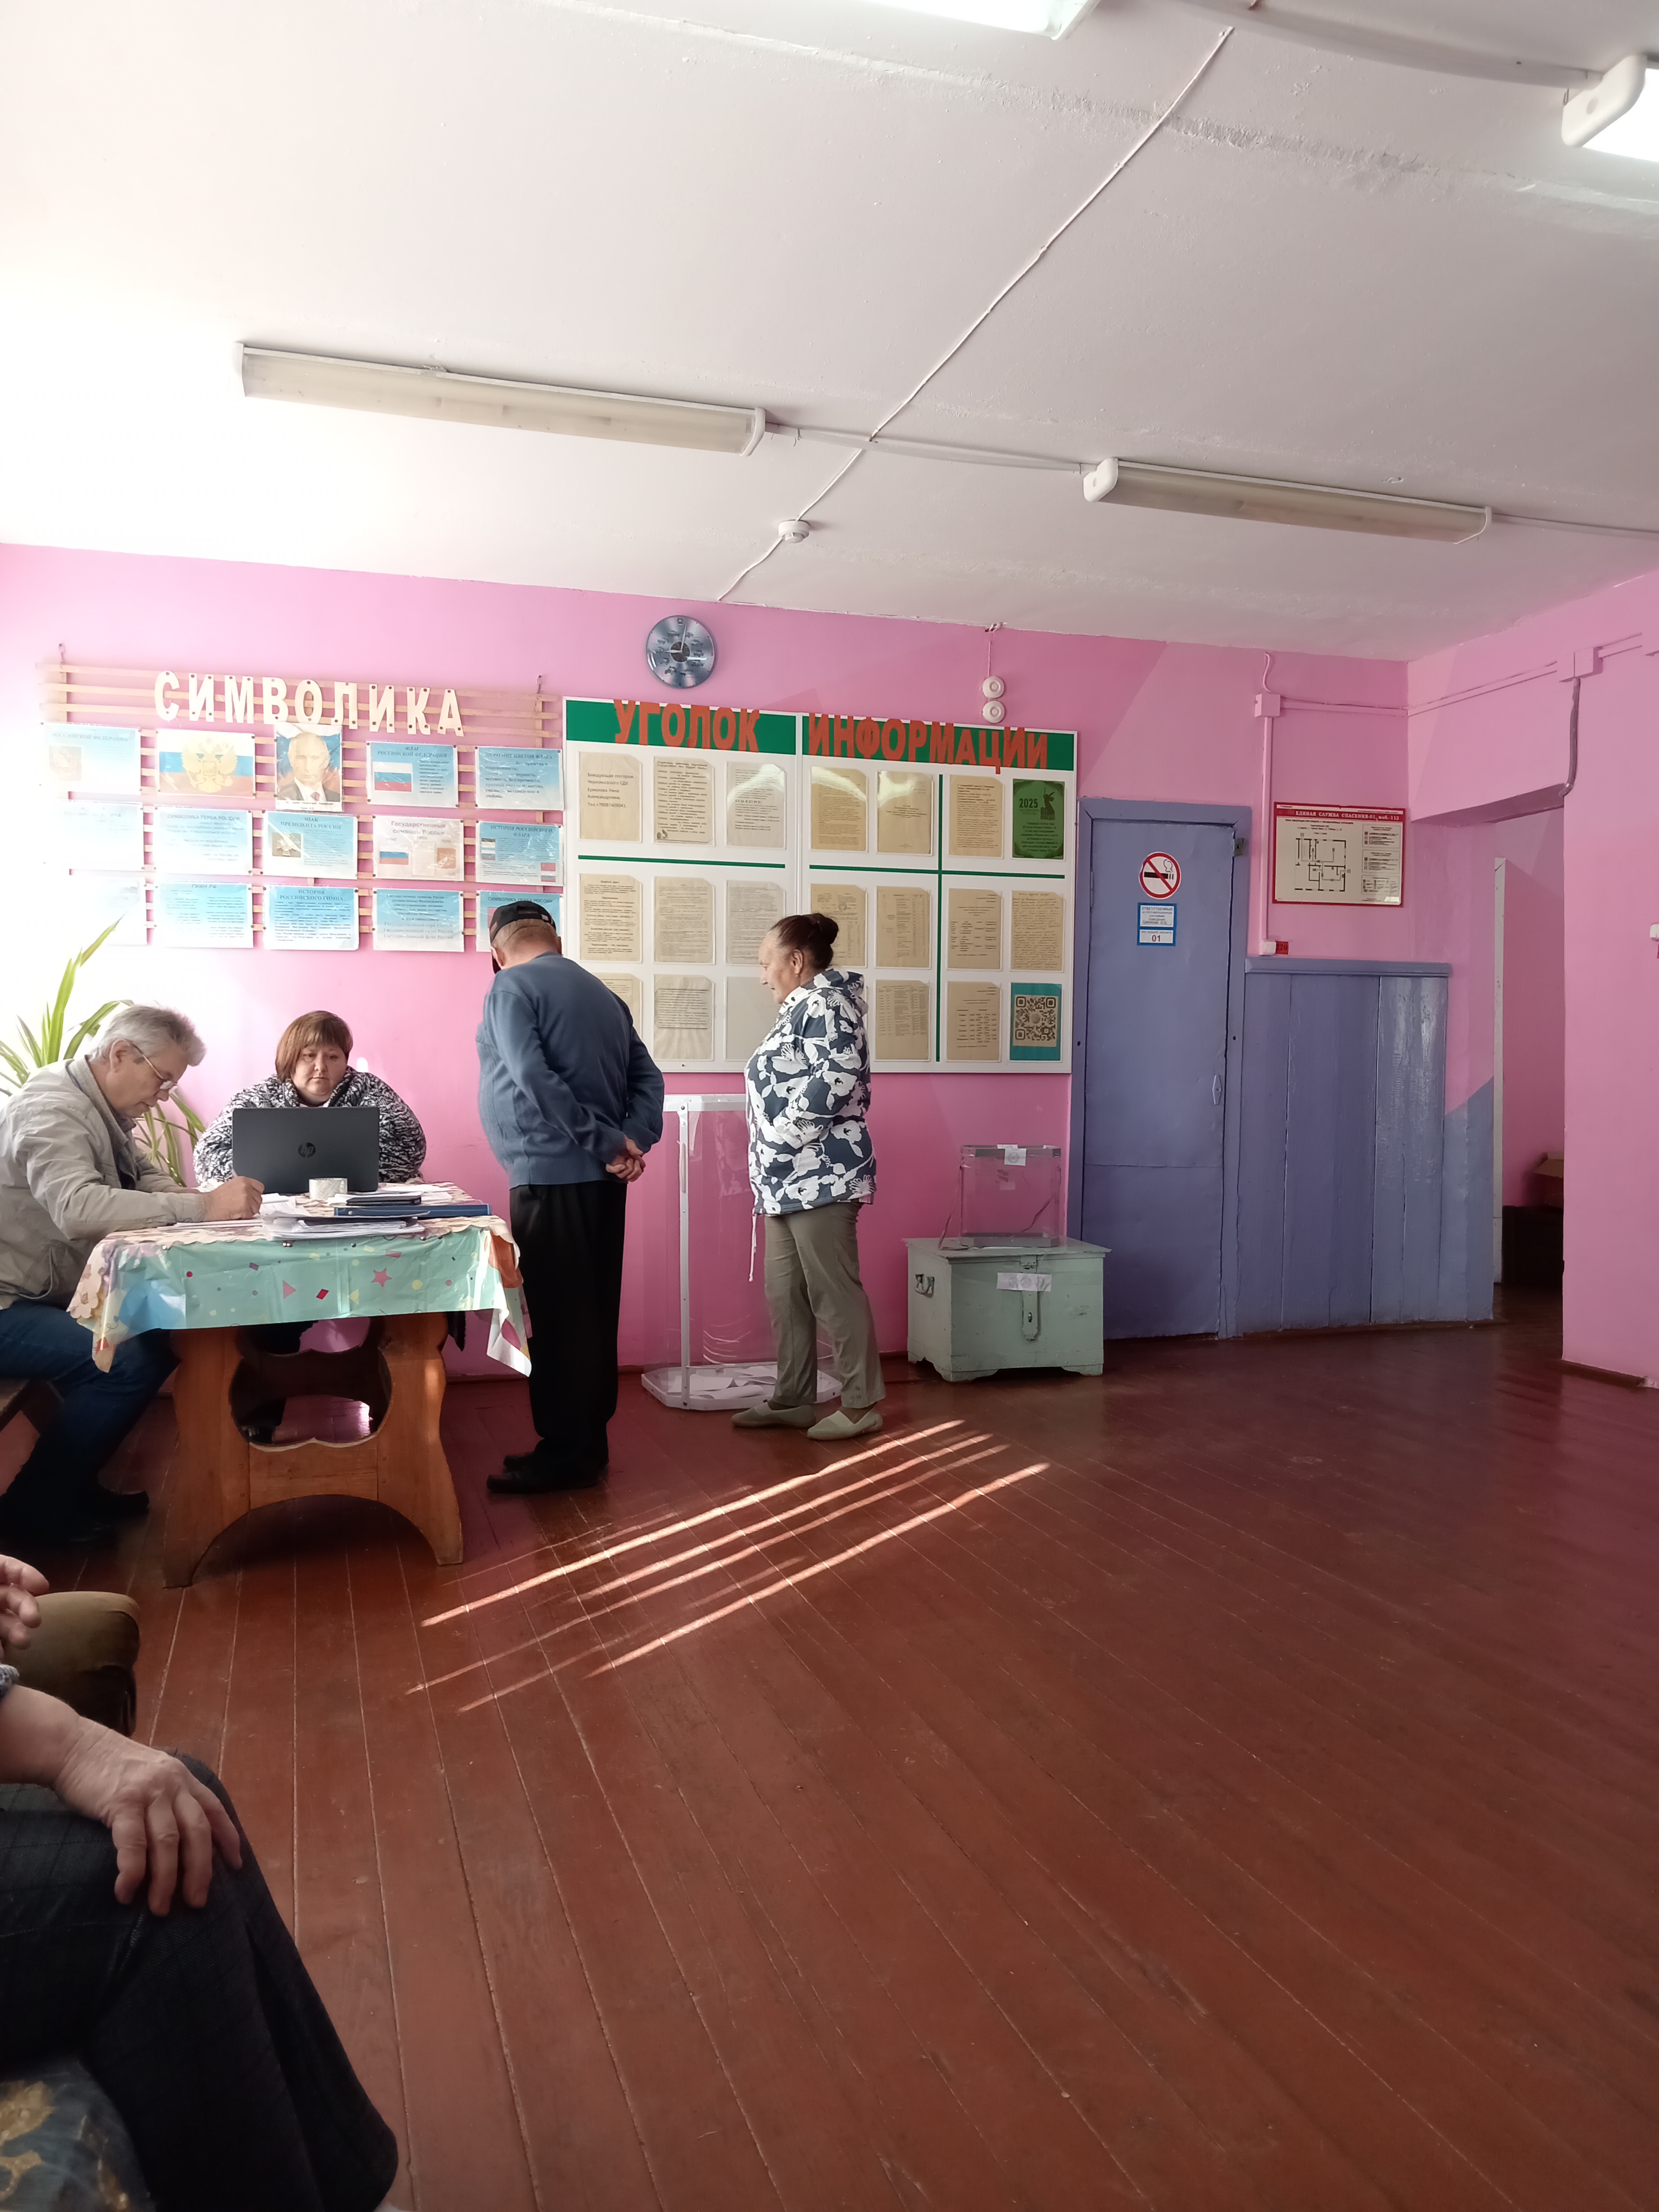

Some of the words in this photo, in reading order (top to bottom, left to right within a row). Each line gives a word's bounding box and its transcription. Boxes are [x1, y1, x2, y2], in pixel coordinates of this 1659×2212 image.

[154, 671, 464, 737] СИМВОЛИКА
[613, 699, 760, 753] УГОЛОК
[808, 713, 1048, 774] ИНФОРМАЦИИ
[1019, 798, 1038, 808] 2025
[391, 820, 446, 828] Государственные
